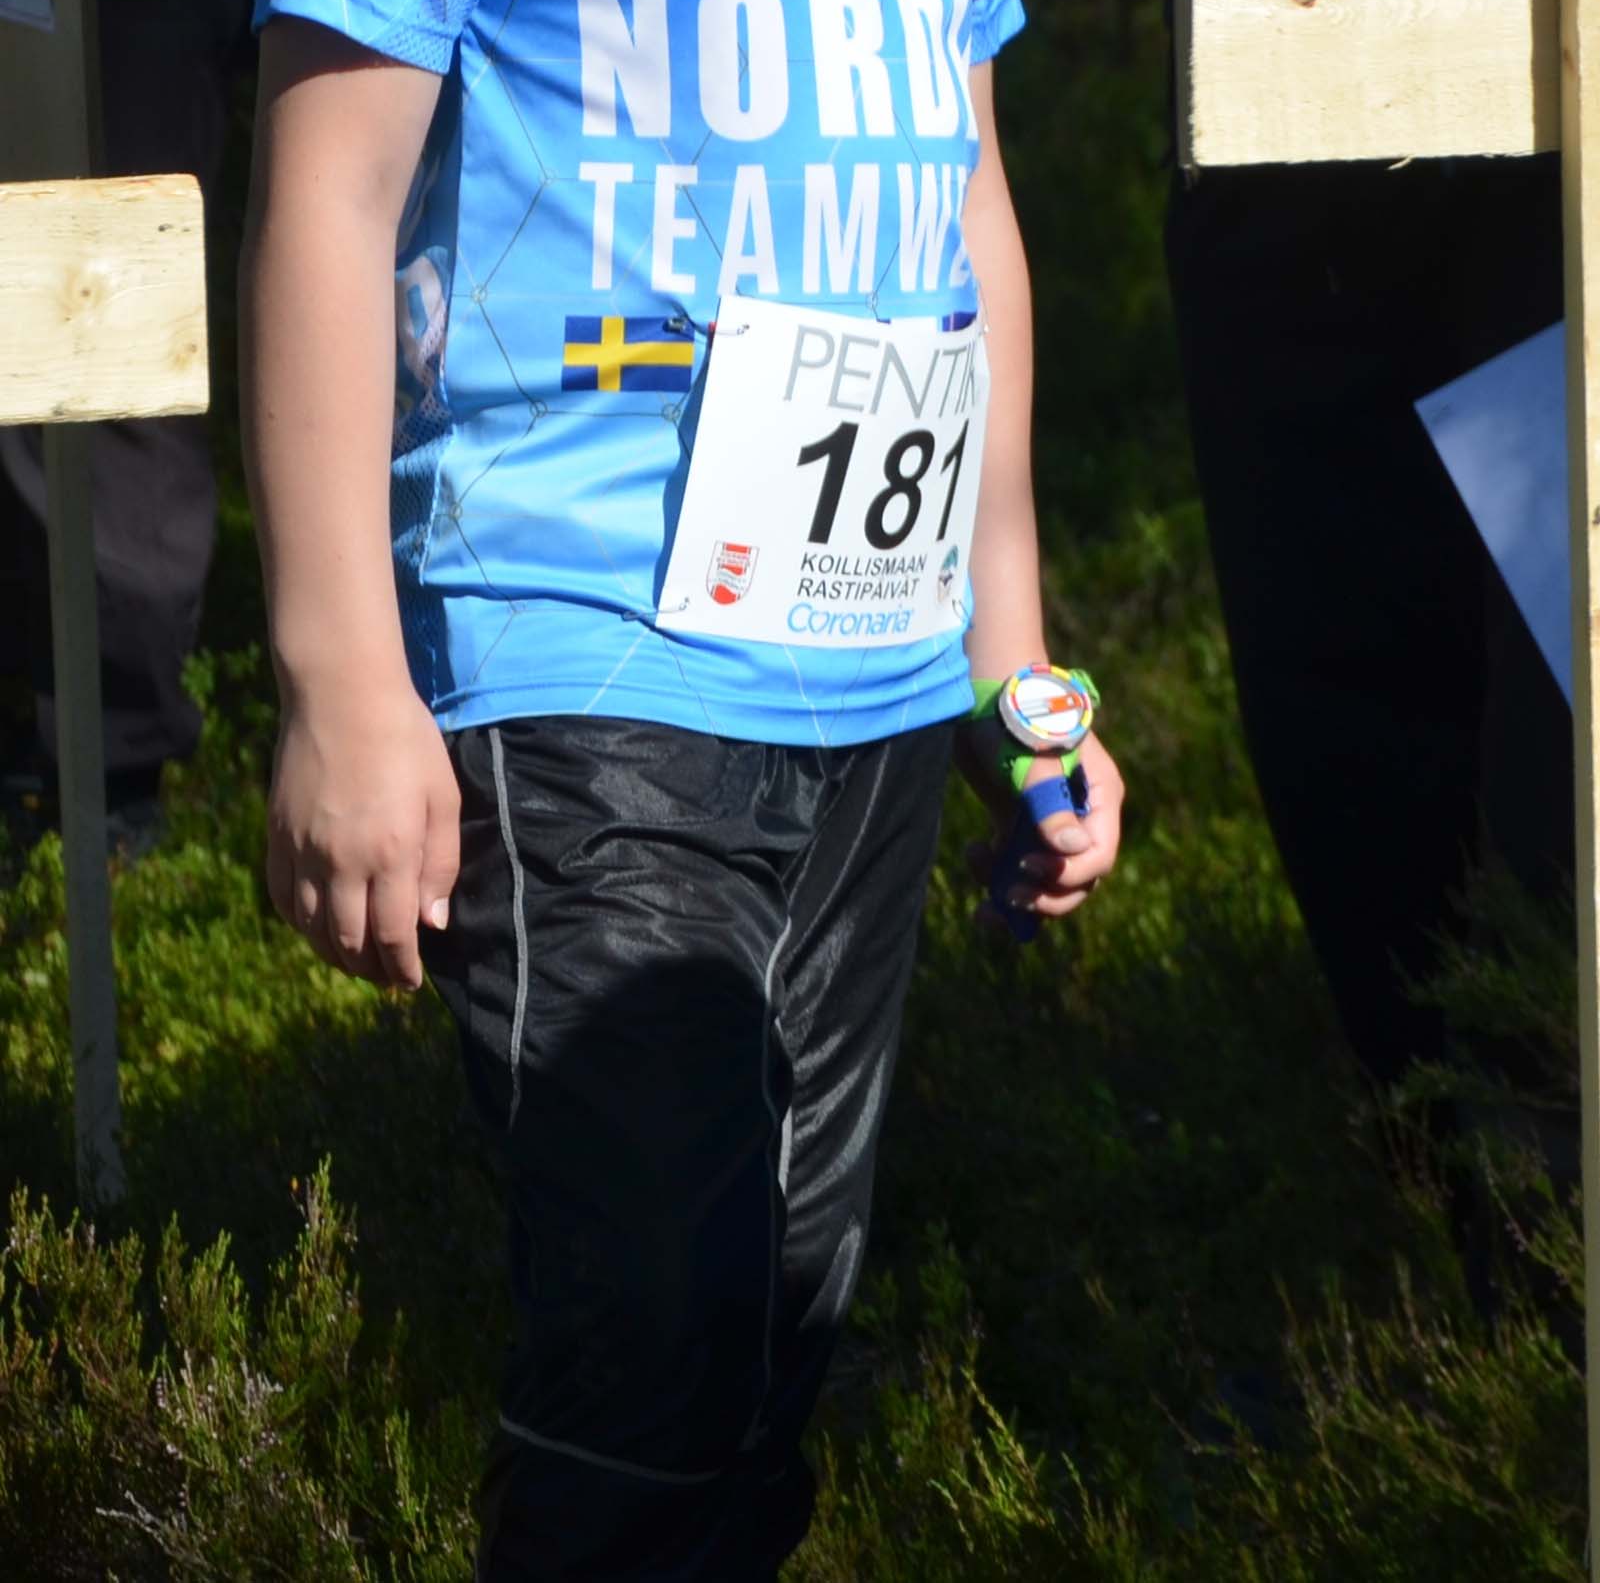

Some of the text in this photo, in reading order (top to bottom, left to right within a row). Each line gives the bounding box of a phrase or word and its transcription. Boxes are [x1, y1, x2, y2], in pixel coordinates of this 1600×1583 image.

[796, 418, 970, 551] 181
[800, 551, 929, 578] KOILLISMAAN
[796, 576, 921, 602] RASTIPÄIVÄT
[786, 602, 914, 636] Coronaria
